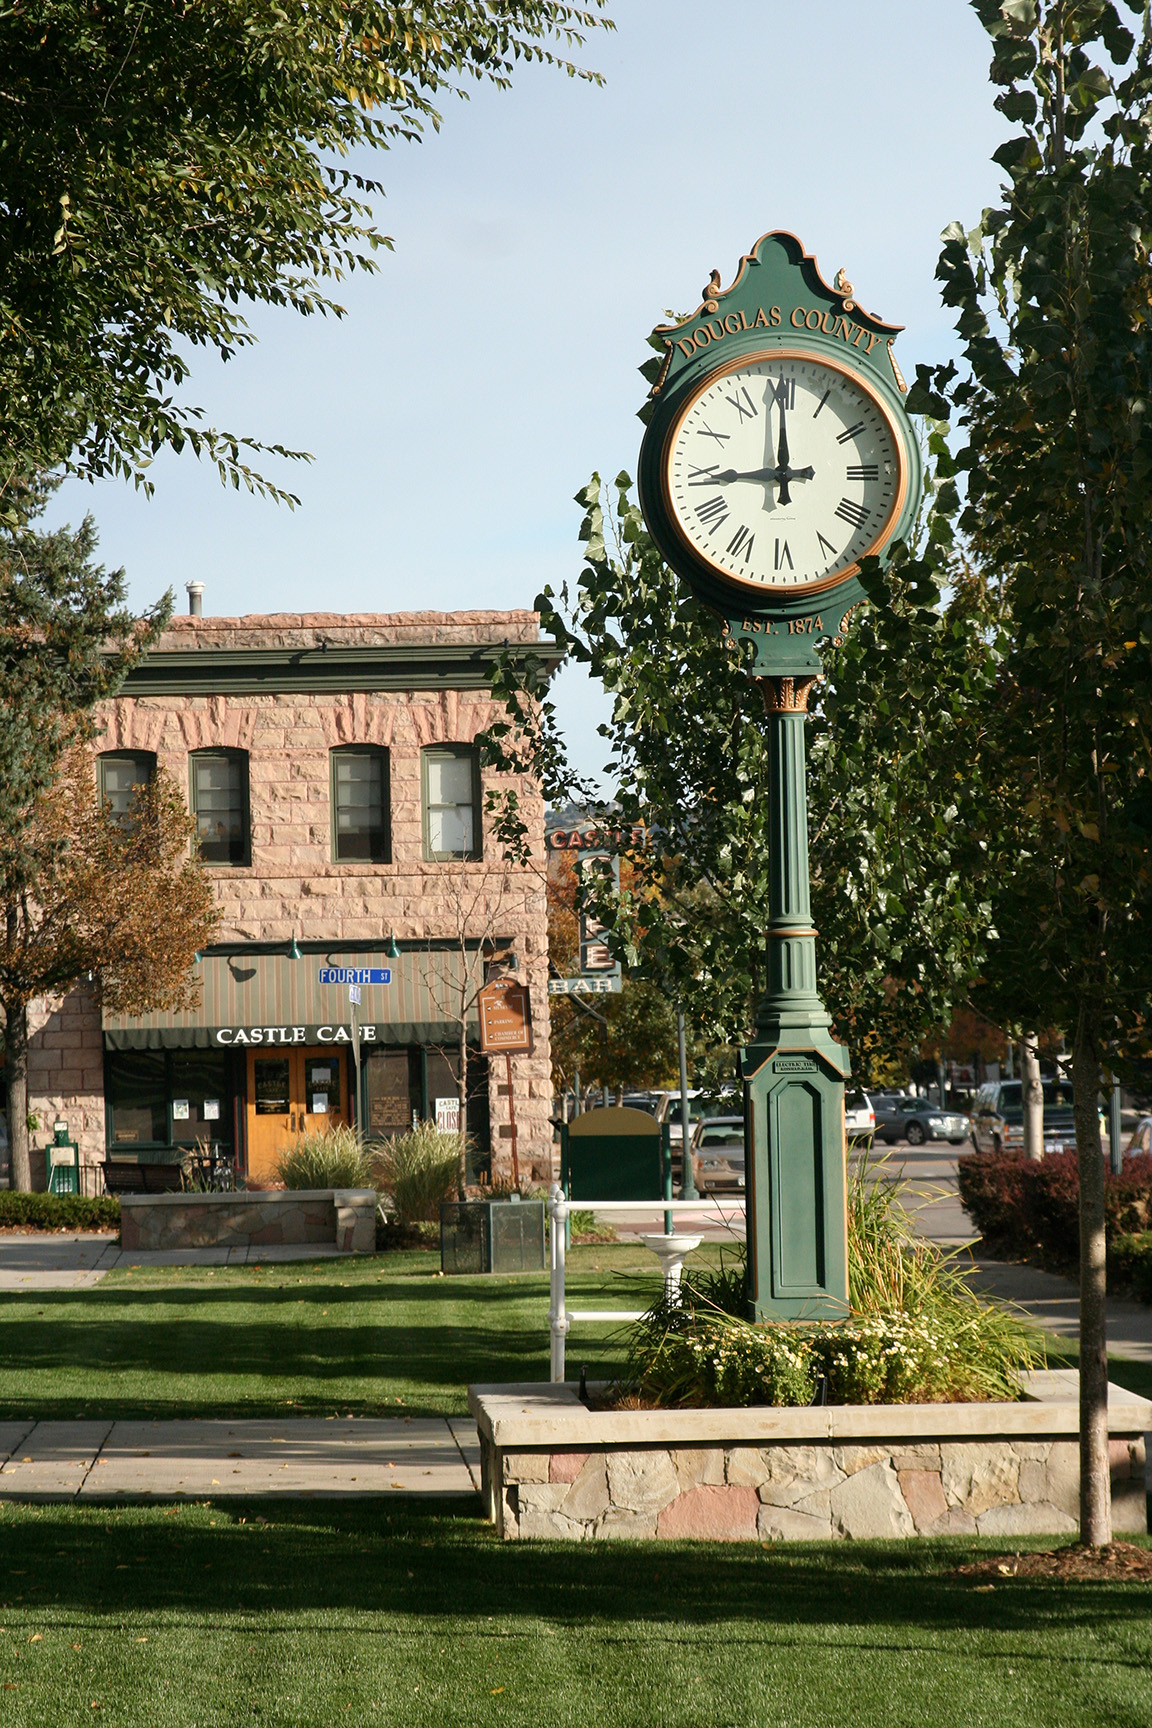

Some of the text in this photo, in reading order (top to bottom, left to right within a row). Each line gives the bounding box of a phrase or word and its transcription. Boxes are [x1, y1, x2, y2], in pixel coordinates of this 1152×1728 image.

[676, 306, 883, 359] DOUGLAS COUNTY
[725, 386, 758, 425] XI
[696, 421, 731, 449] X
[846, 464, 879, 481] III
[774, 538, 795, 570] VI
[816, 530, 838, 560] V
[742, 615, 824, 635] EST. 1874
[550, 830, 642, 848] CASE
[321, 969, 388, 983] FOURTH ST
[550, 978, 616, 994] BAR
[216, 1026, 376, 1044] CASTLE CAE
[437, 1111, 460, 1130] CLOS
